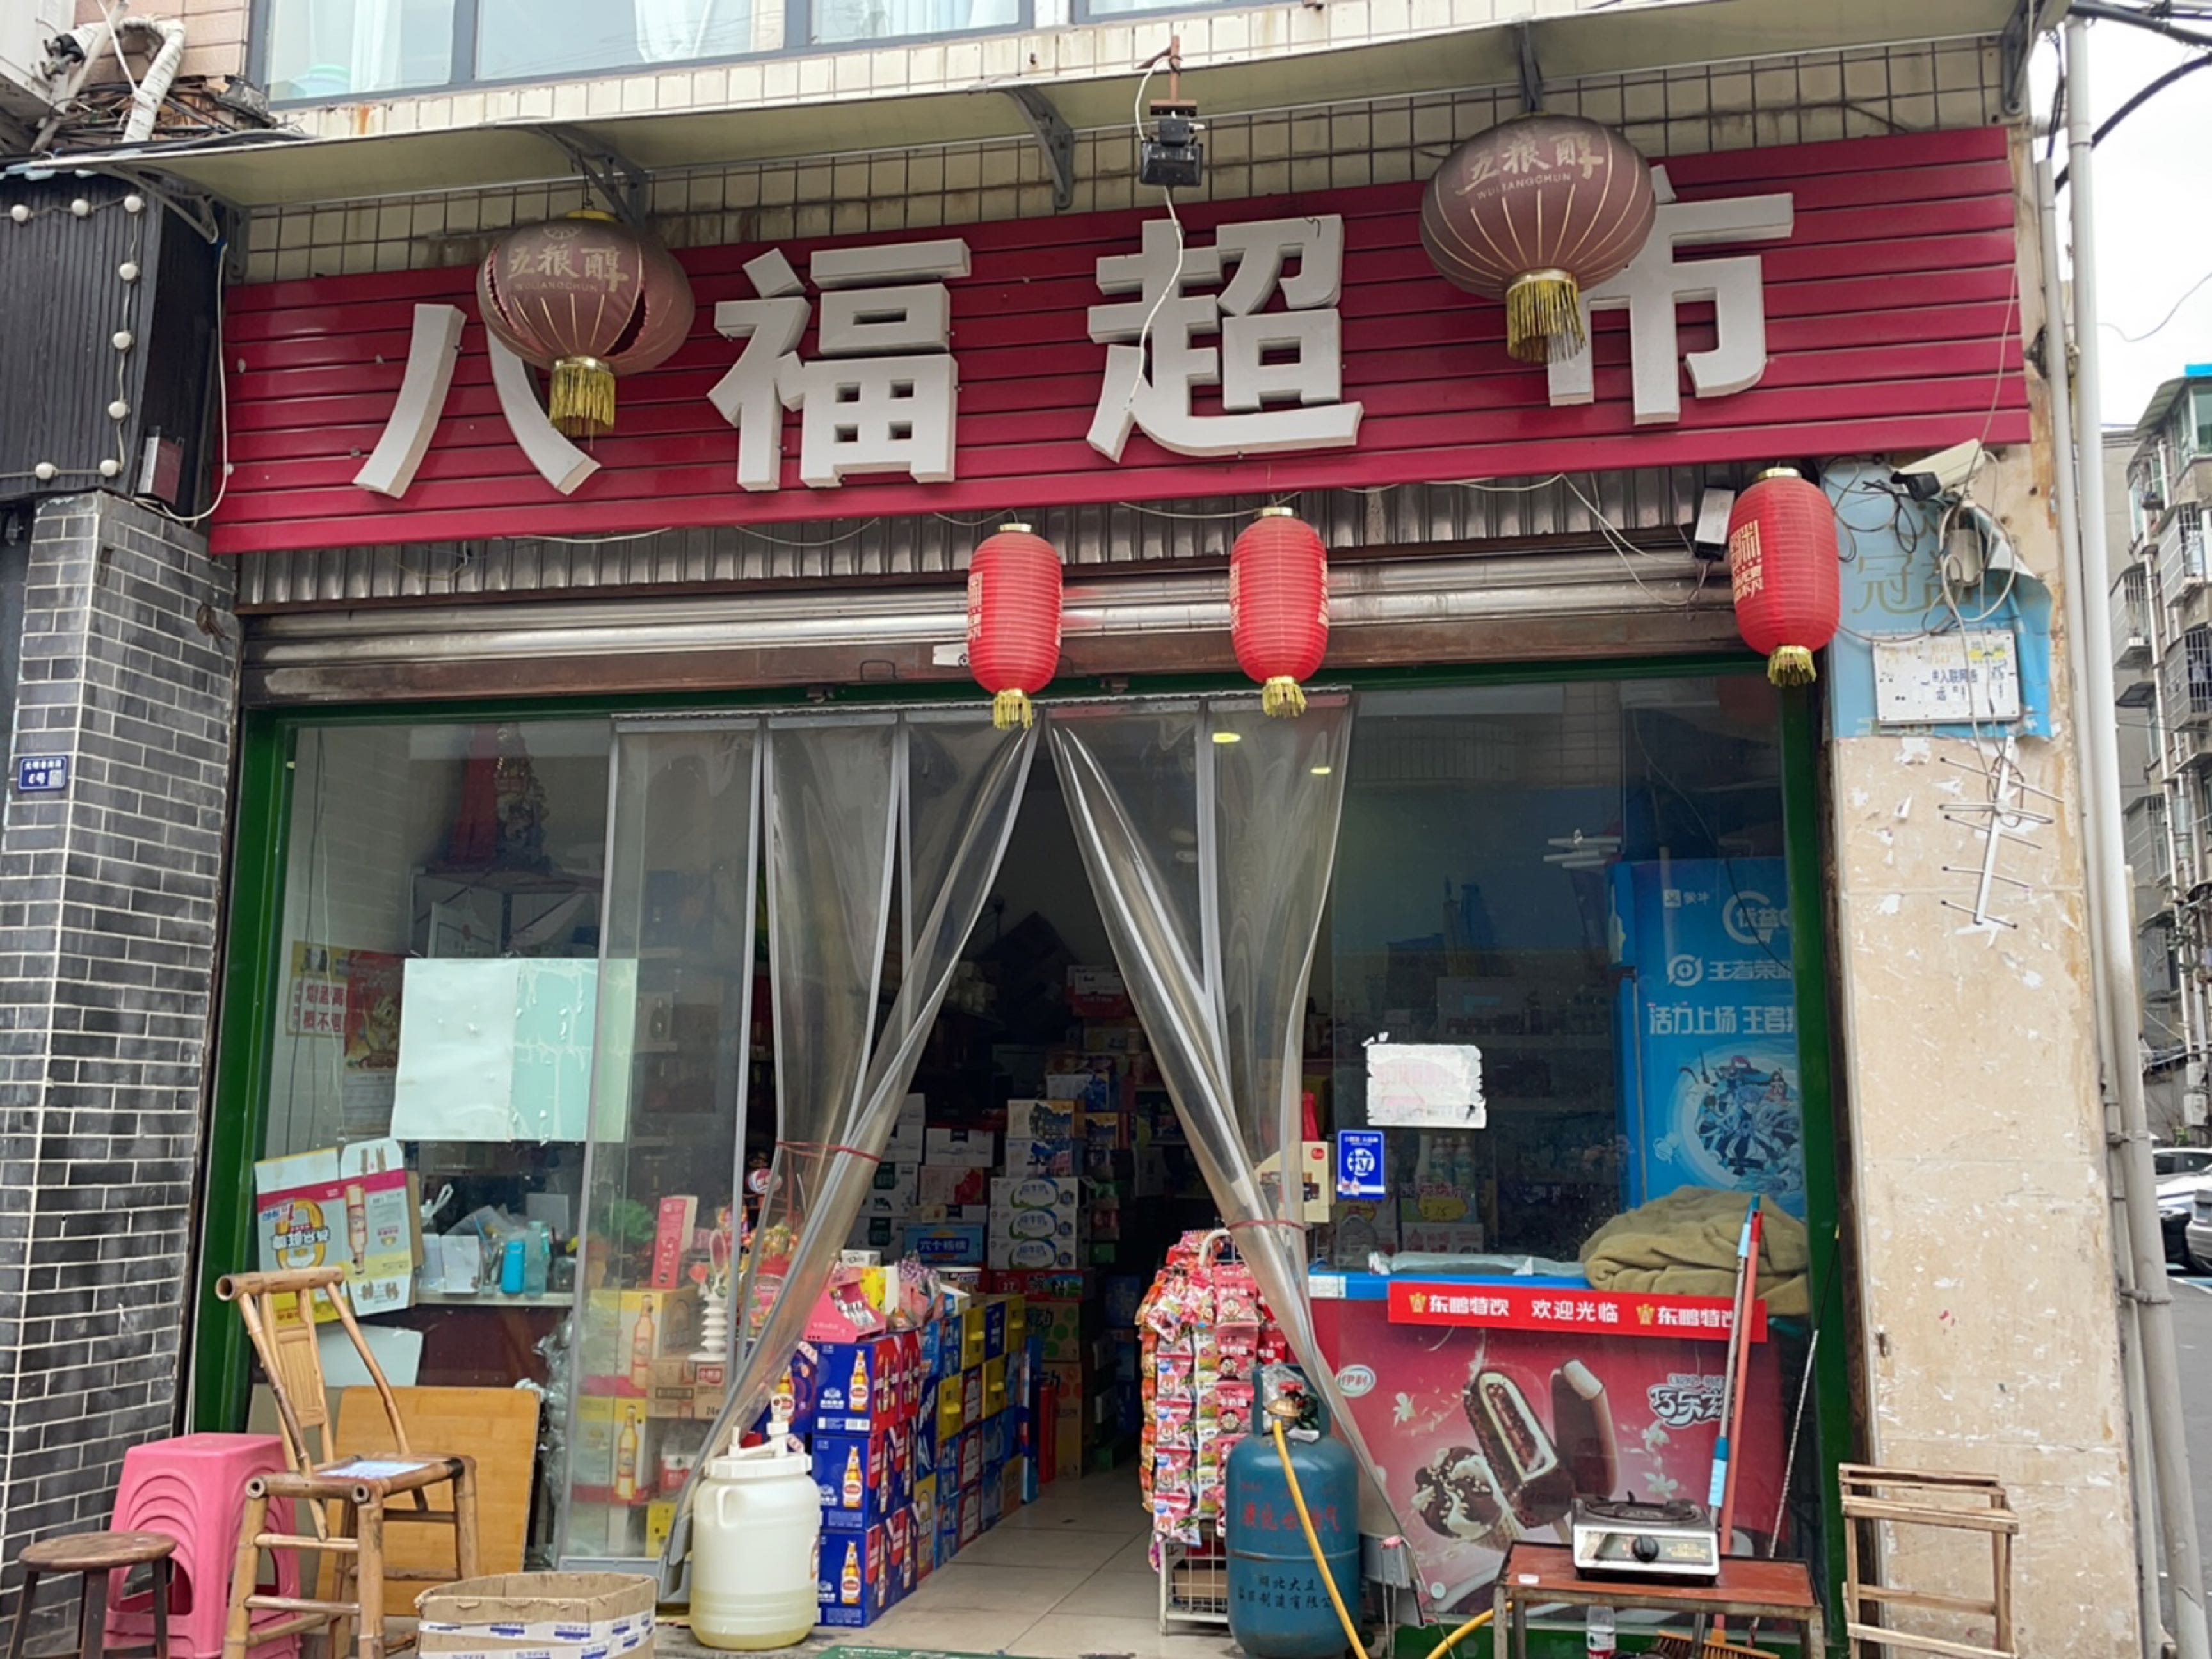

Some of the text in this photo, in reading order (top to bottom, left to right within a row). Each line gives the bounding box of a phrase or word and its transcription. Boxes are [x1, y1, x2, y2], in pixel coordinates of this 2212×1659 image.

[1477, 172, 1571, 200] WULIANGCHUN
[352, 163, 1794, 498] 八福超市
[1649, 1004, 1736, 1034] 活力上场
[1428, 1294, 1510, 1317] 东鹏特饮
[1531, 1300, 1619, 1324] 欢迎光临
